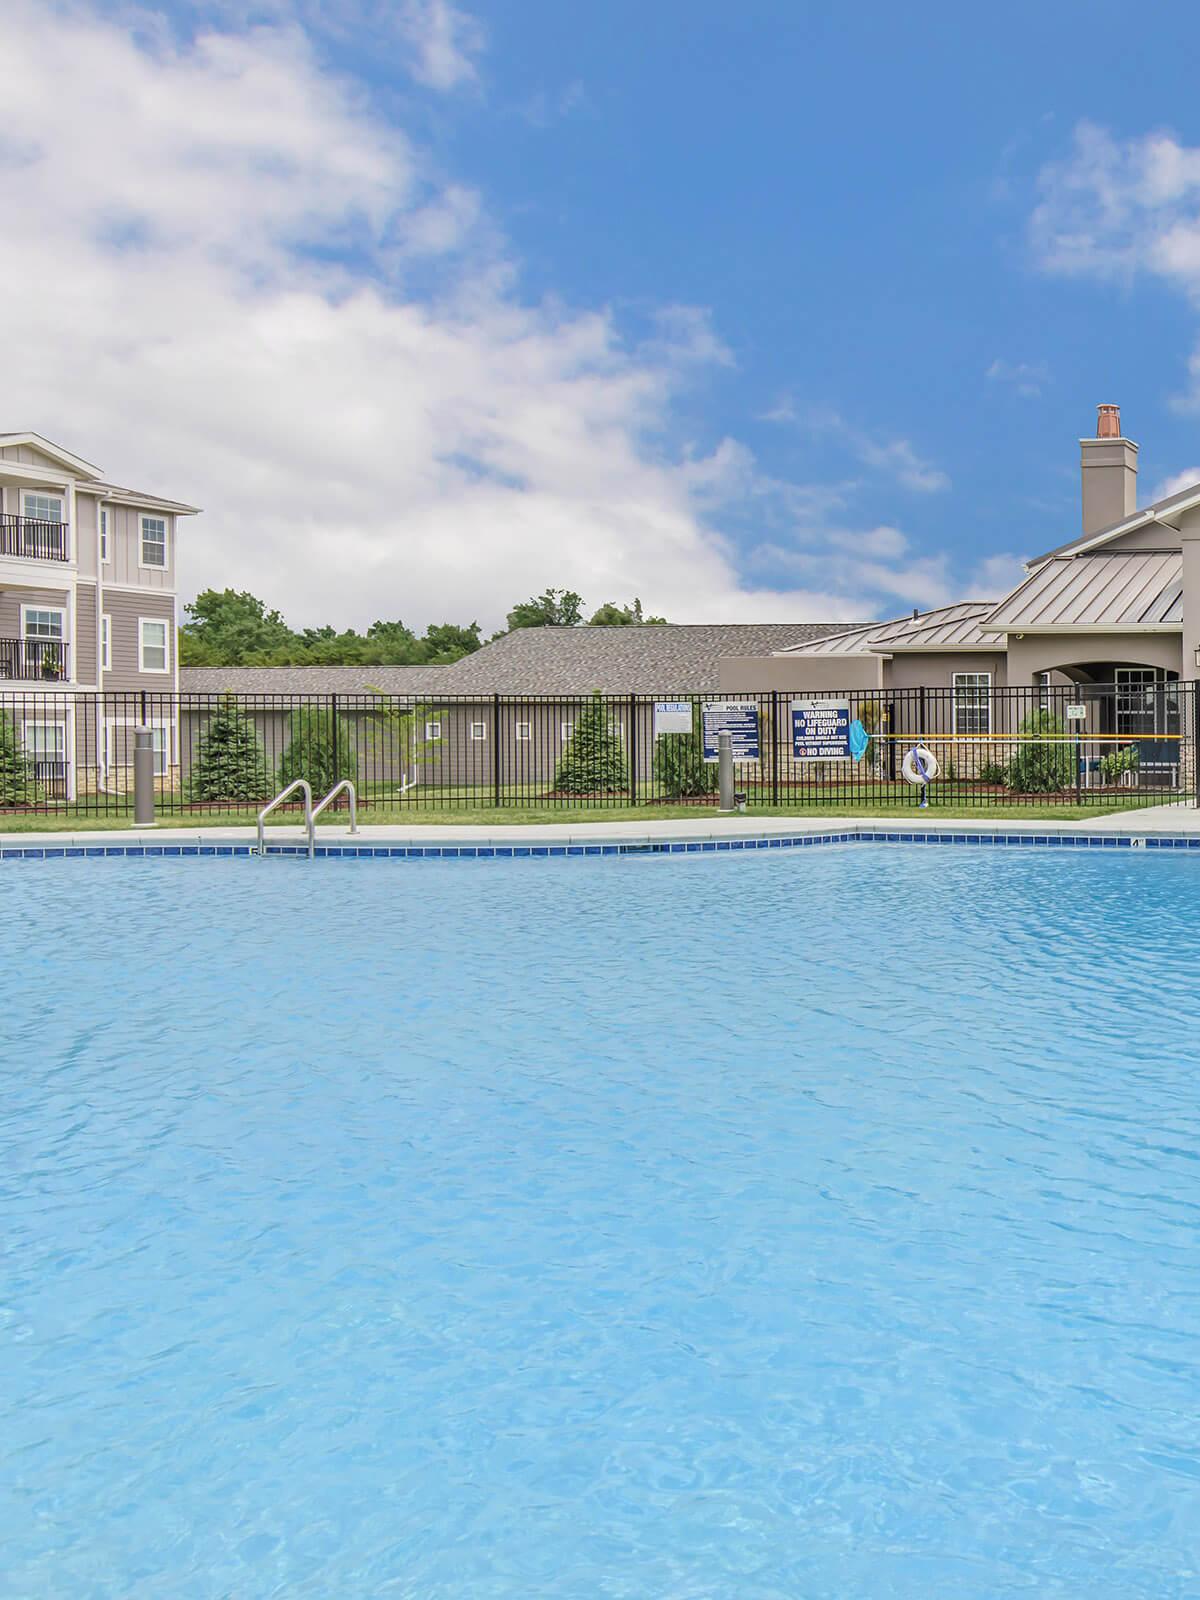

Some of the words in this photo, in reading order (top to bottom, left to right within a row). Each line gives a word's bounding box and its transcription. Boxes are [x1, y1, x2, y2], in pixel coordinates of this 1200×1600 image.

[803, 711, 838, 719] WARNING
[794, 719, 806, 728] NO
[807, 718, 847, 727] LIFEGUARD
[805, 727, 816, 735] ON
[817, 727, 836, 735] DUTY
[806, 748, 818, 756] NO
[819, 748, 844, 756] DIVING
